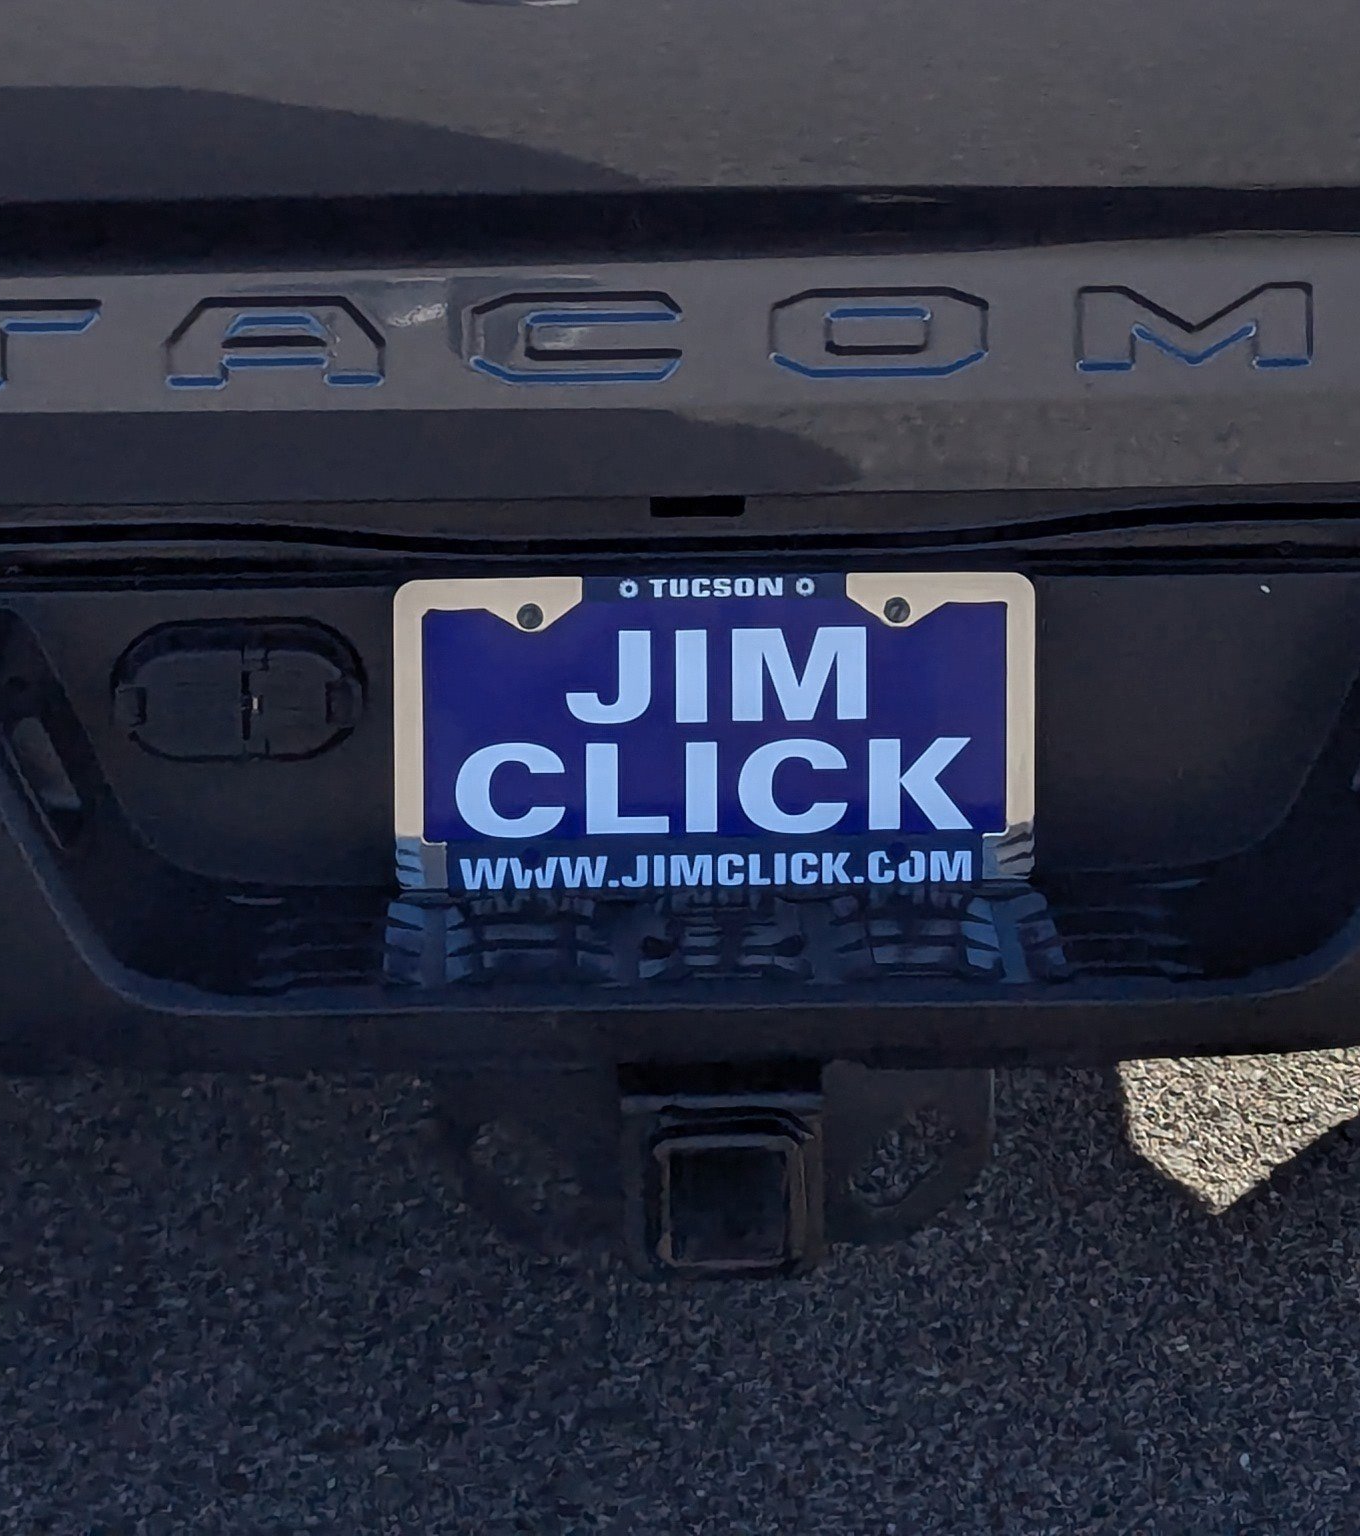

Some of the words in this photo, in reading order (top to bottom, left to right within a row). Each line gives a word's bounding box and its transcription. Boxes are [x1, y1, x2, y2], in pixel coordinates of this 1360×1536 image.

[648, 576, 784, 599] TUCSON
[565, 625, 869, 725] JIM
[454, 736, 973, 839] CLICK
[458, 849, 974, 892] WWW.JIMCLICK.COM
